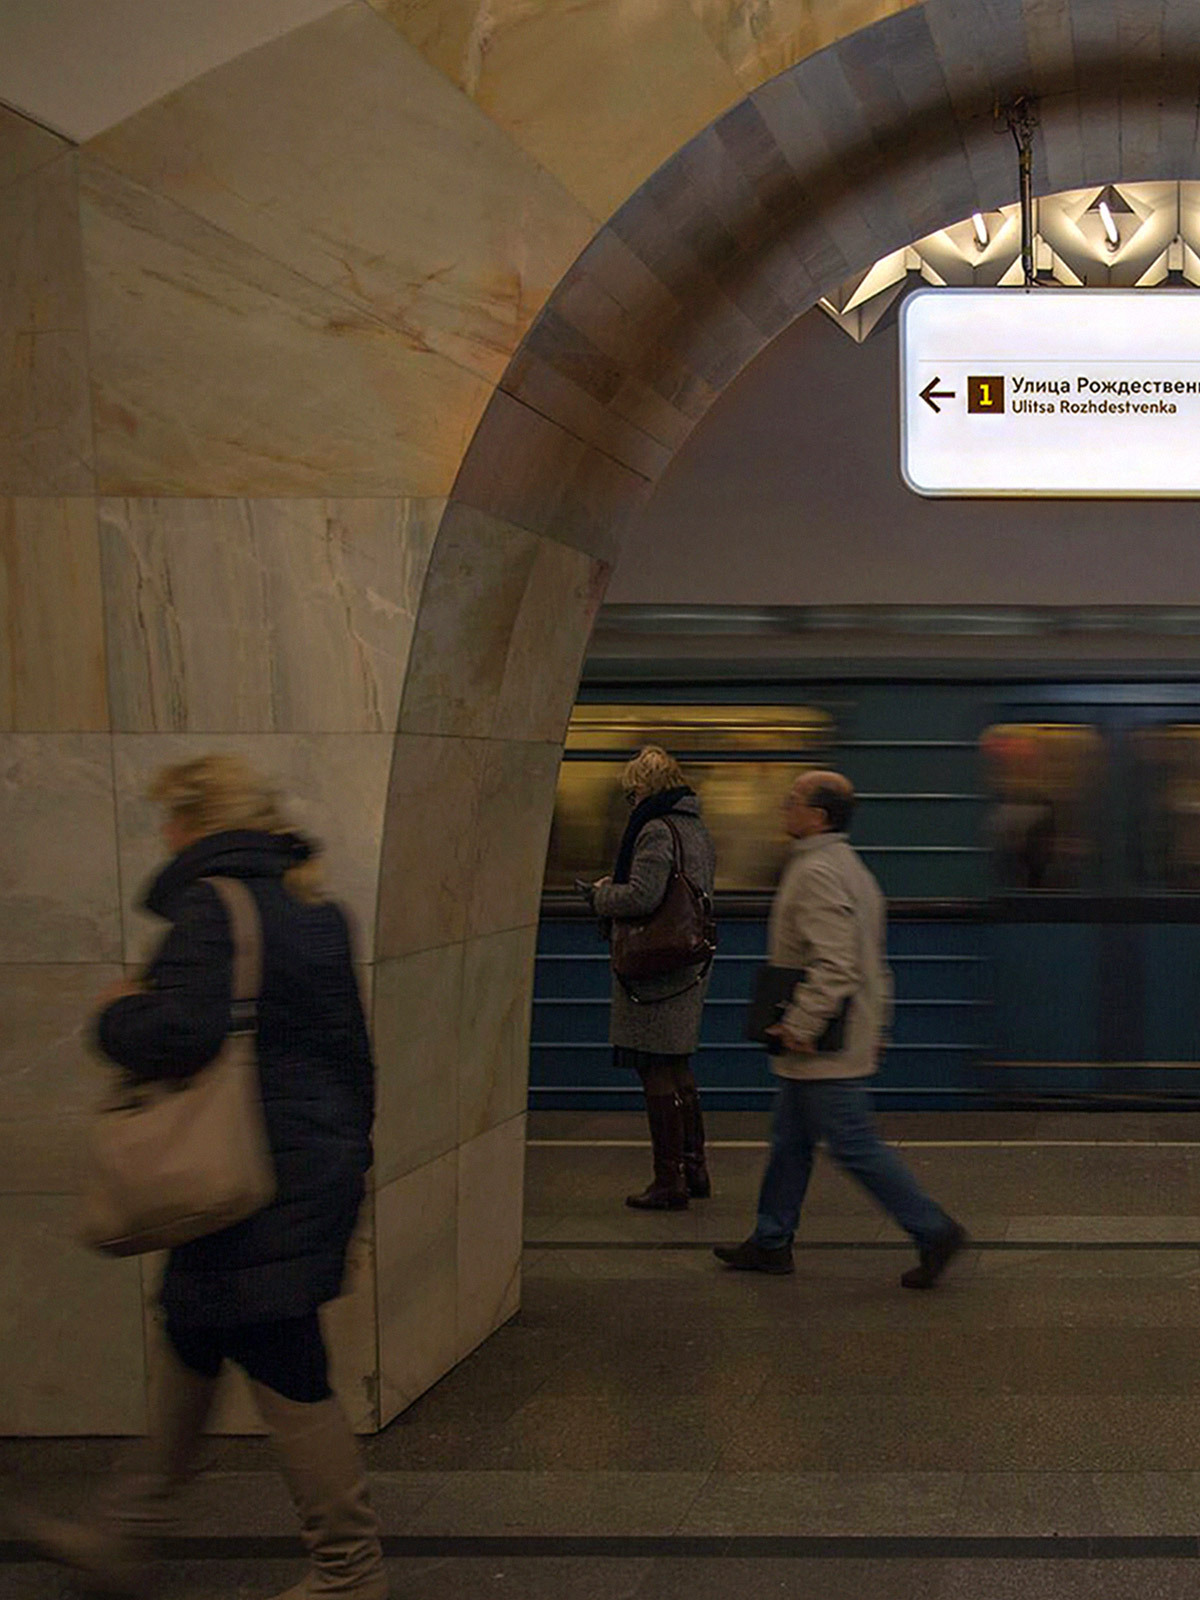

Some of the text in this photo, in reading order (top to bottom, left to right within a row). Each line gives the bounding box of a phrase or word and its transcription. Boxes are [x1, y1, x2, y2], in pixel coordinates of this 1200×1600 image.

[979, 384, 993, 406] 1
[1011, 377, 1072, 397] Улица
[1011, 399, 1177, 414] Ulitsa Rozhdestvenka
